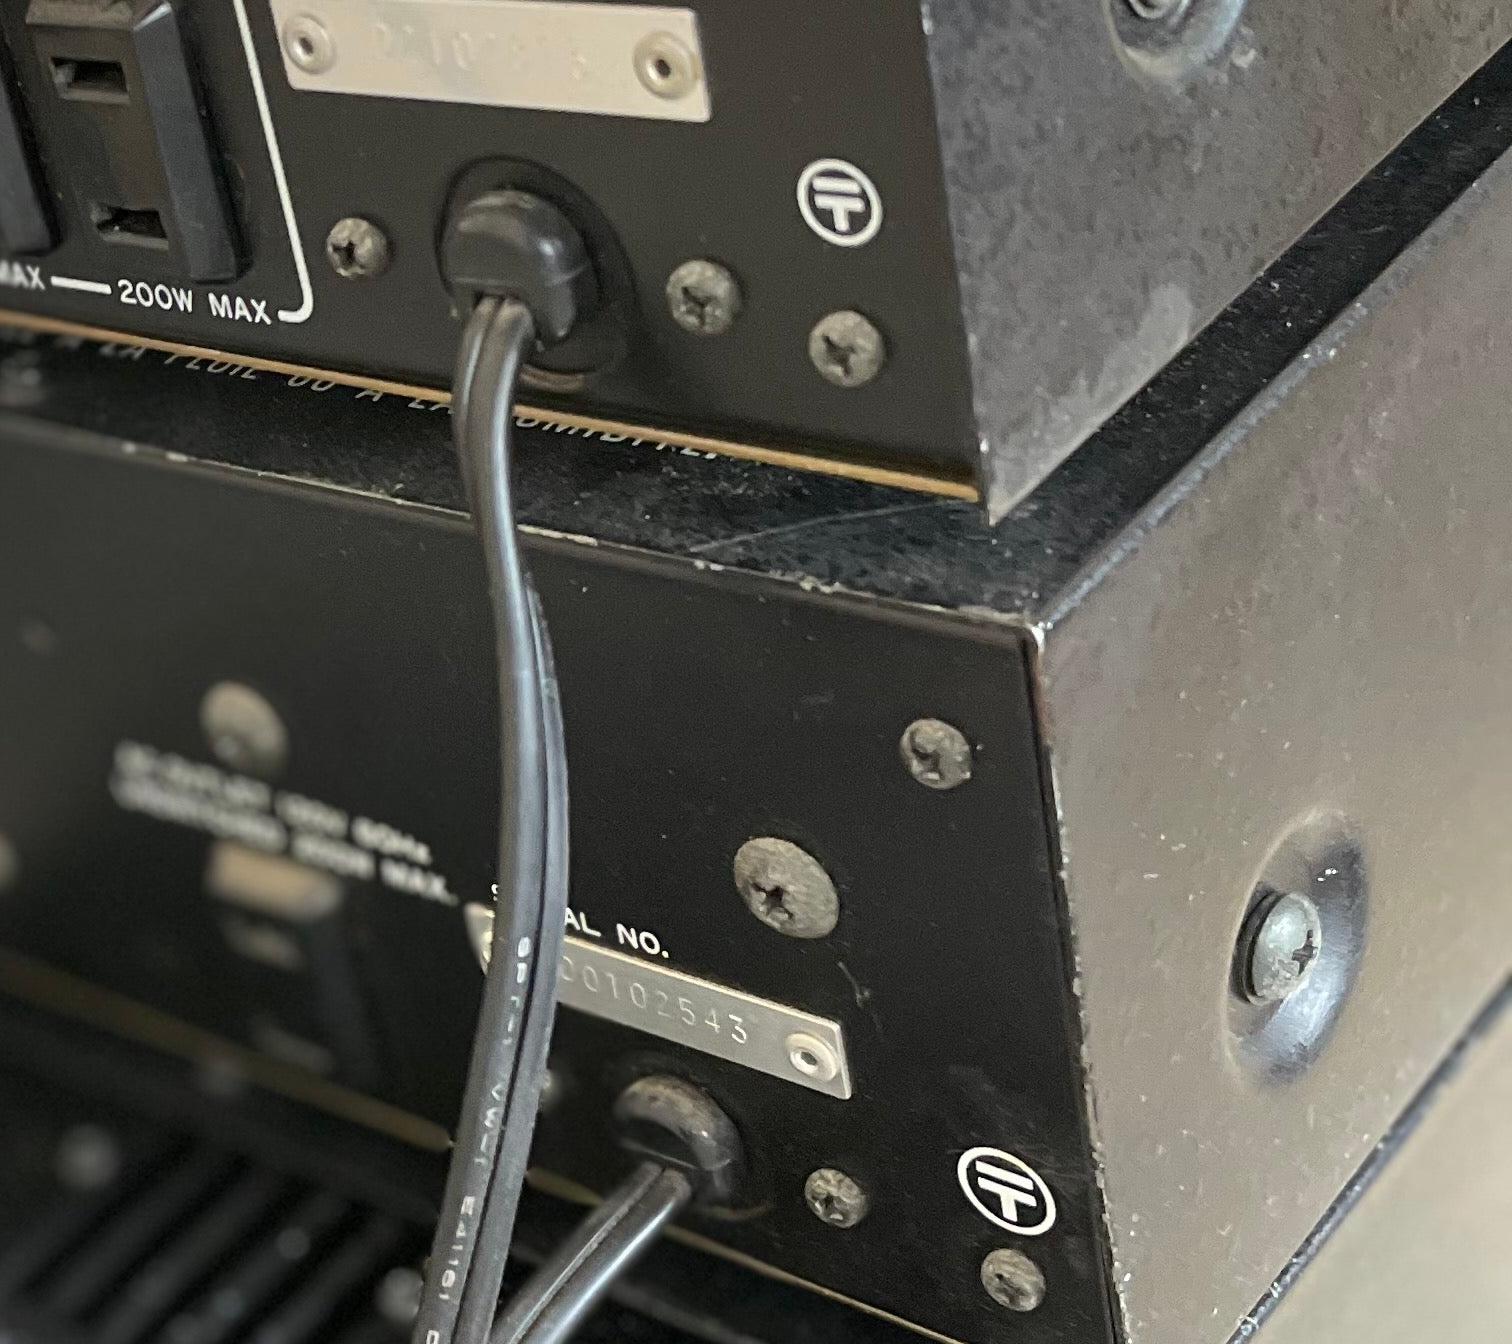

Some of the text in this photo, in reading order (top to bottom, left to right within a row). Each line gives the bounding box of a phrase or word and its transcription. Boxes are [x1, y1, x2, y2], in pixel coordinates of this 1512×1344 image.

[117, 279, 272, 325] 200W MAX
[616, 923, 669, 959] NO.
